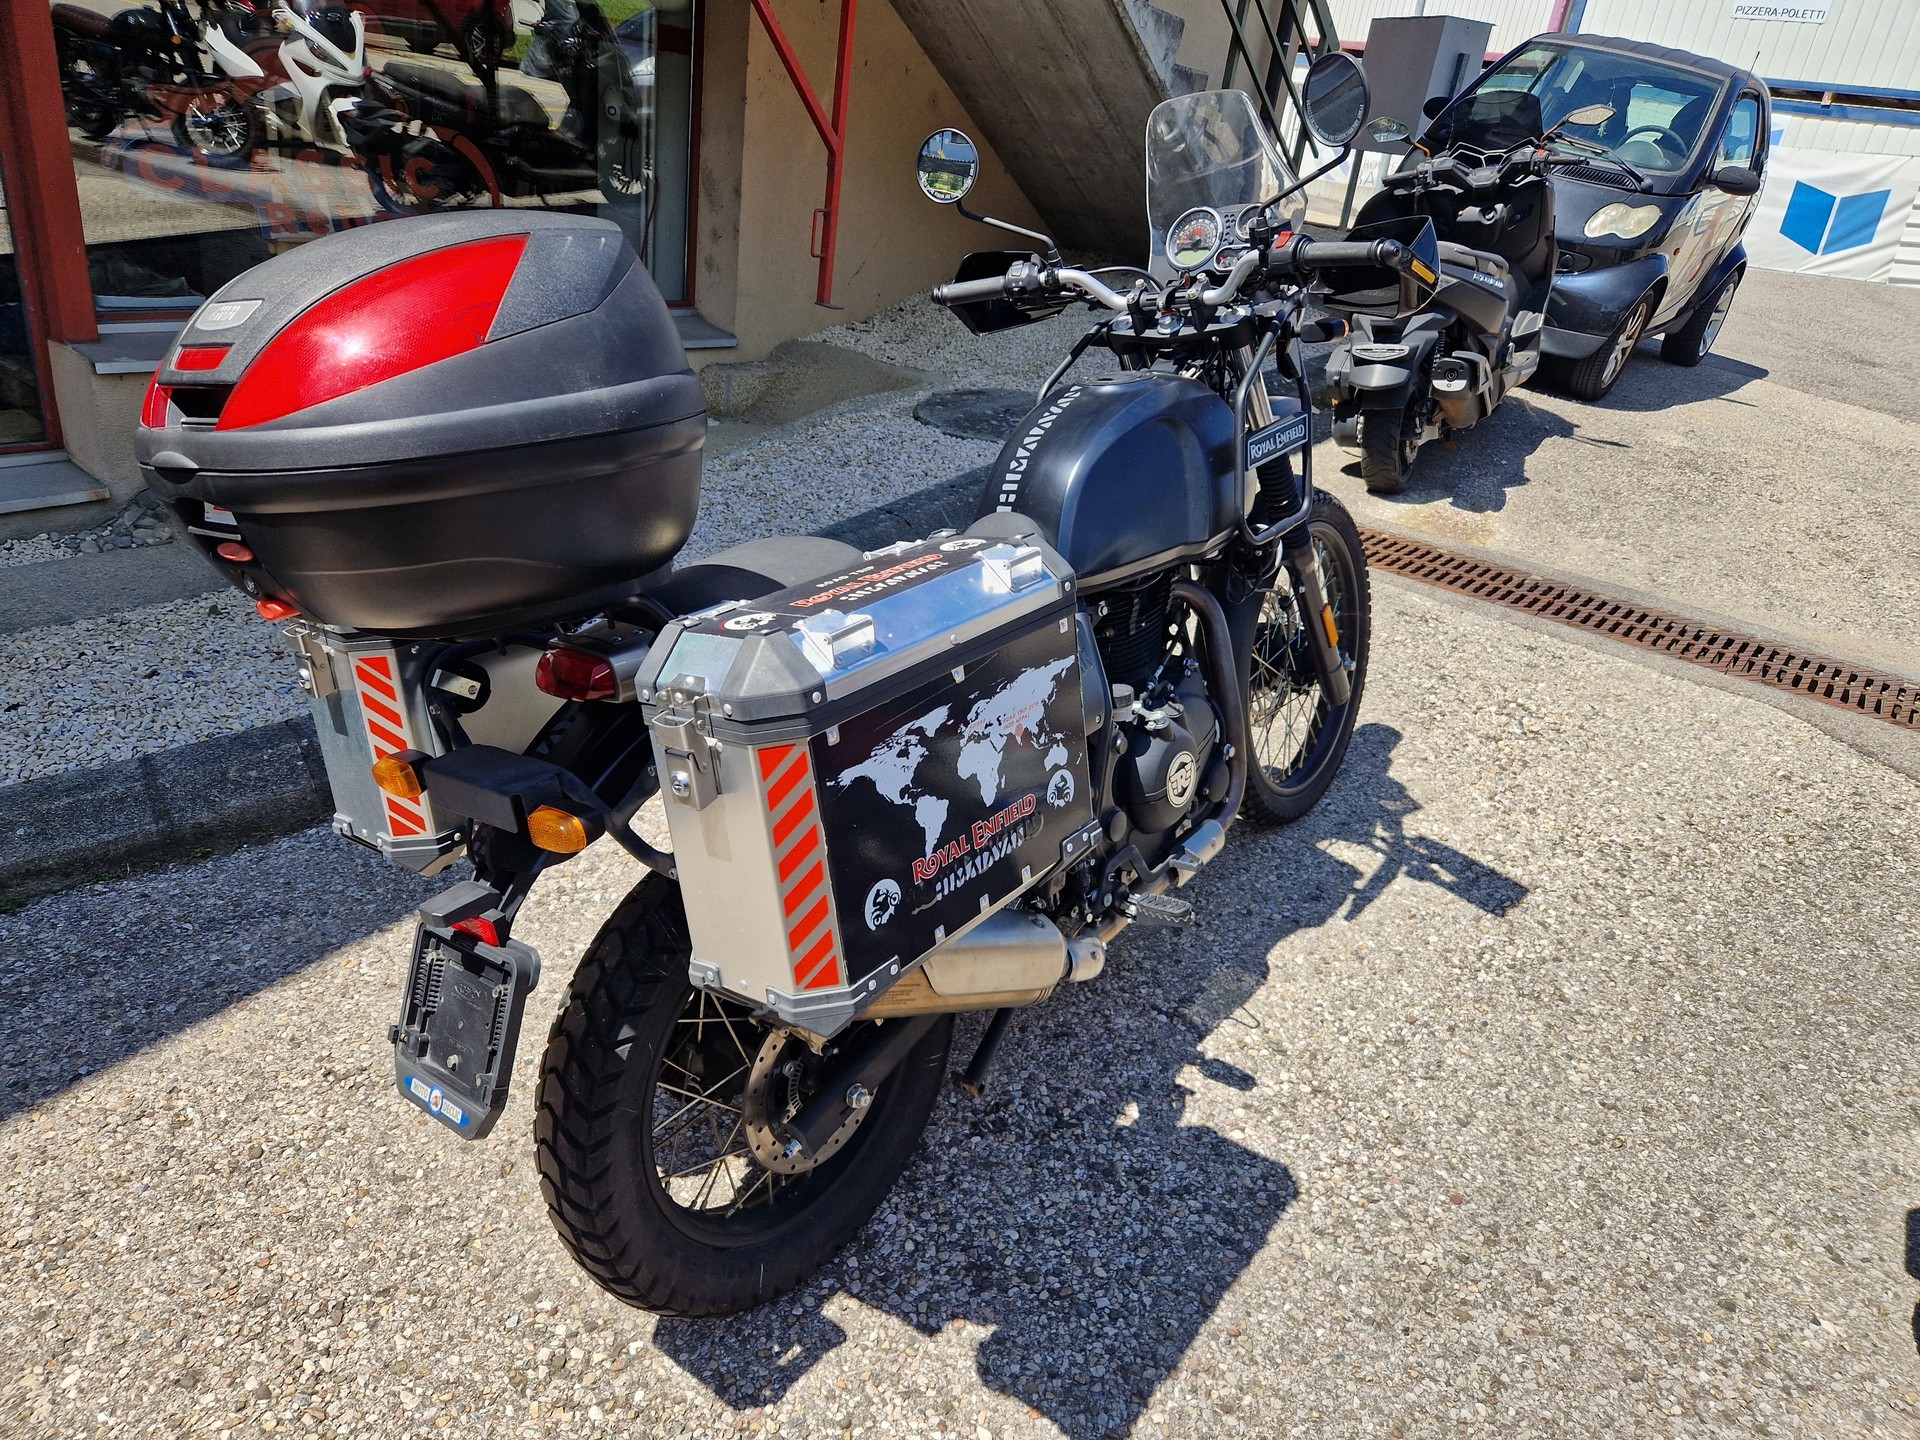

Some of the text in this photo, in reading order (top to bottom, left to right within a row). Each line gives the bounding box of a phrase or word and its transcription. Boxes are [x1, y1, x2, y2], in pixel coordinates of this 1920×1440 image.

[1734, 5, 1826, 20] PIZZERA-POLETTI
[1249, 424, 1305, 460] ROYAL ENFIELD
[789, 553, 944, 608] ROYAL ENFIELD
[912, 793, 1037, 885] ROYAL ENFIELD
